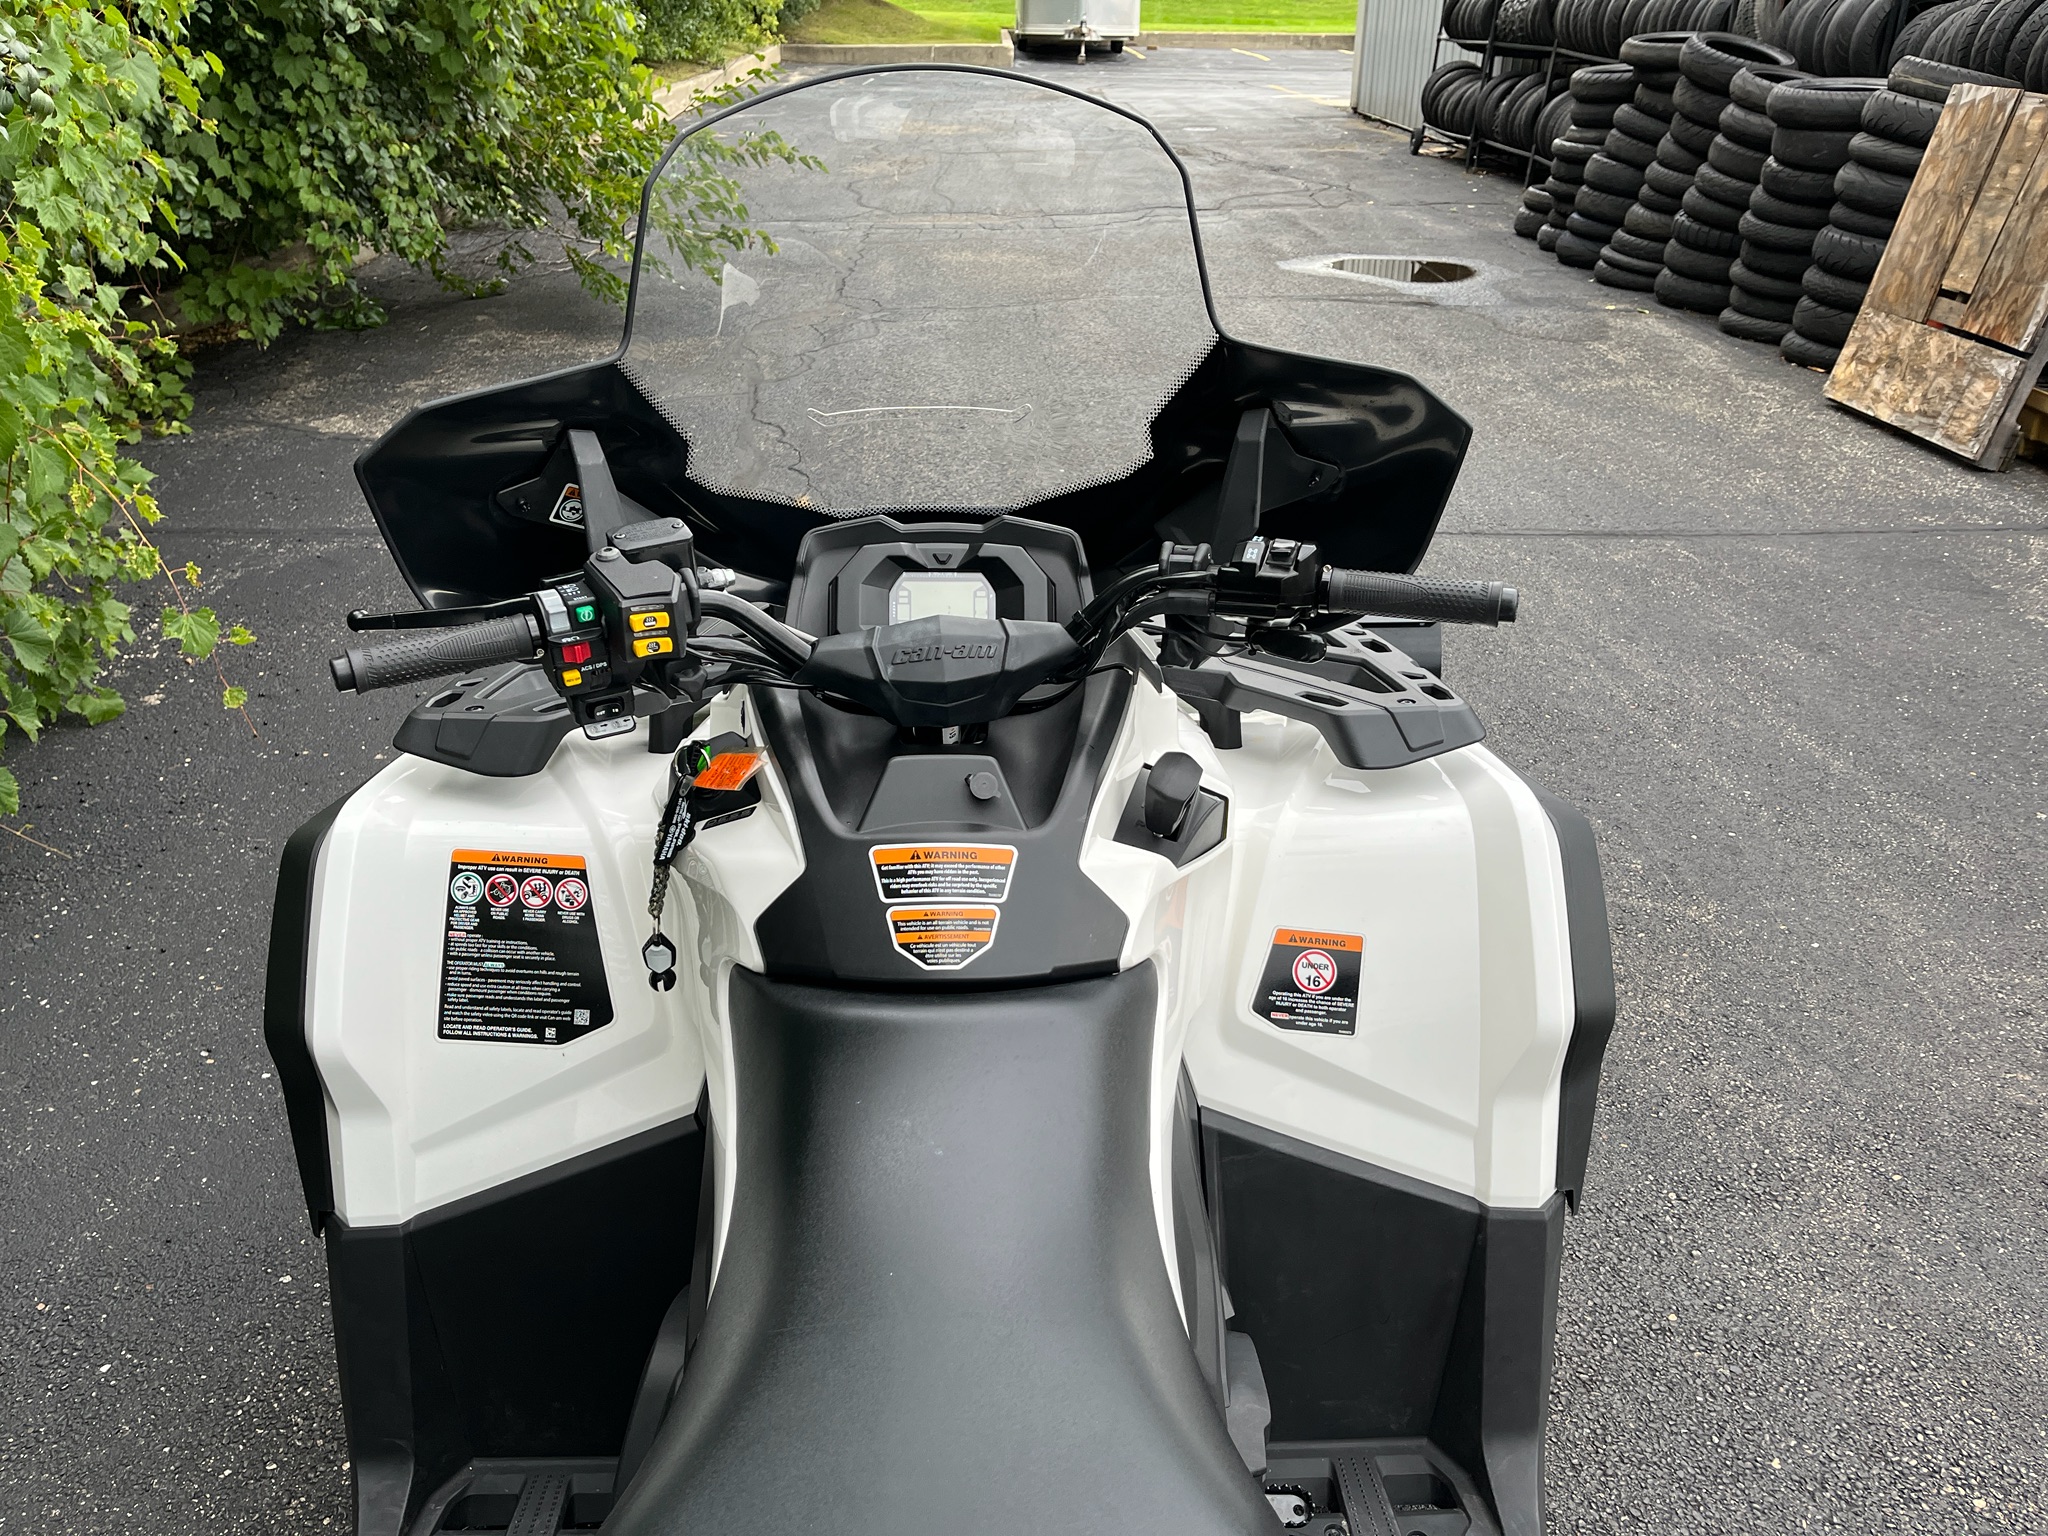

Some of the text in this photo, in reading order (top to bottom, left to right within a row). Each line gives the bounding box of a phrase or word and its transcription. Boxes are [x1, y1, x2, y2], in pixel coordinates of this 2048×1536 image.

[892, 645, 998, 665] can-am
[659, 833, 674, 860] YAMAHA
[502, 856, 548, 864] WARNING
[1299, 936, 1346, 947] WARNING
[1302, 962, 1329, 971] UNDER
[1306, 975, 1320, 987] 16
